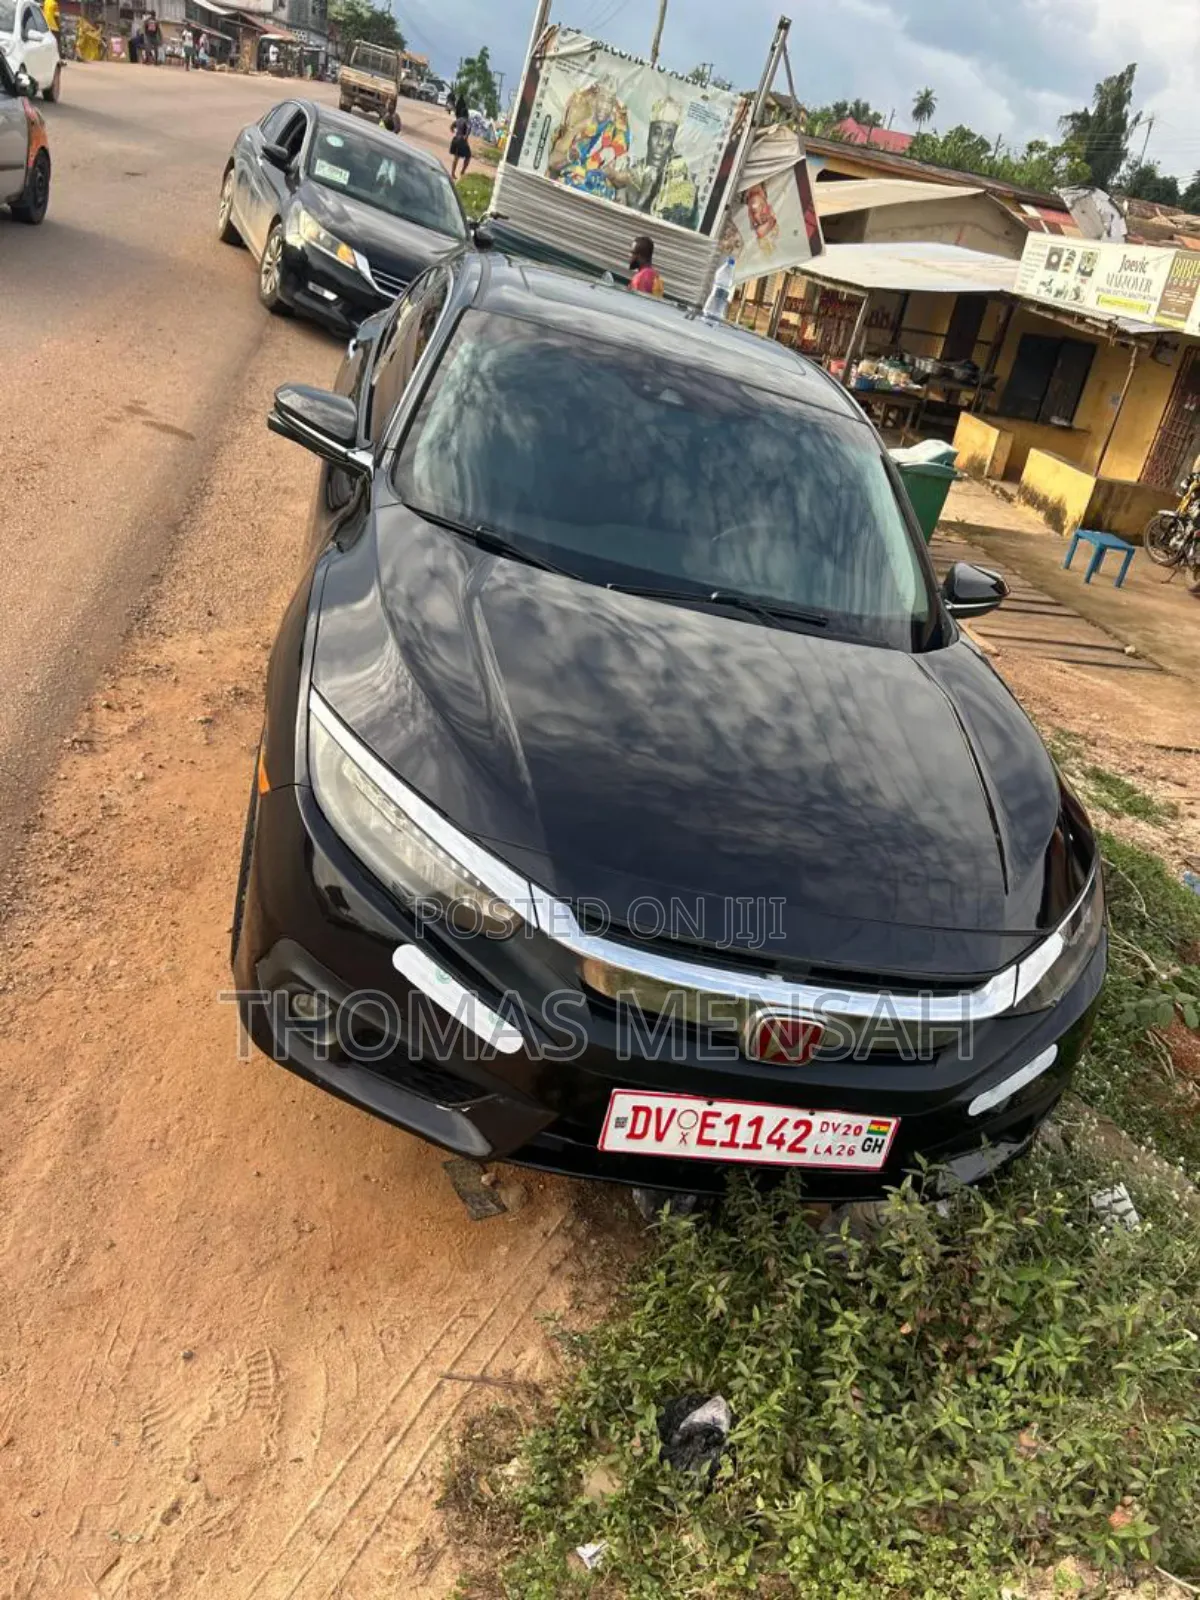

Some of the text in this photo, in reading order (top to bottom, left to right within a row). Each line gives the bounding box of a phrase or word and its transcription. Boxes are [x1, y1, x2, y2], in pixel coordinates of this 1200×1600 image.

[626, 1105, 813, 1154] DV E1142
[819, 1121, 863, 1137] DV20
[813, 1143, 856, 1157] LA26
[861, 1137, 885, 1154] GH
